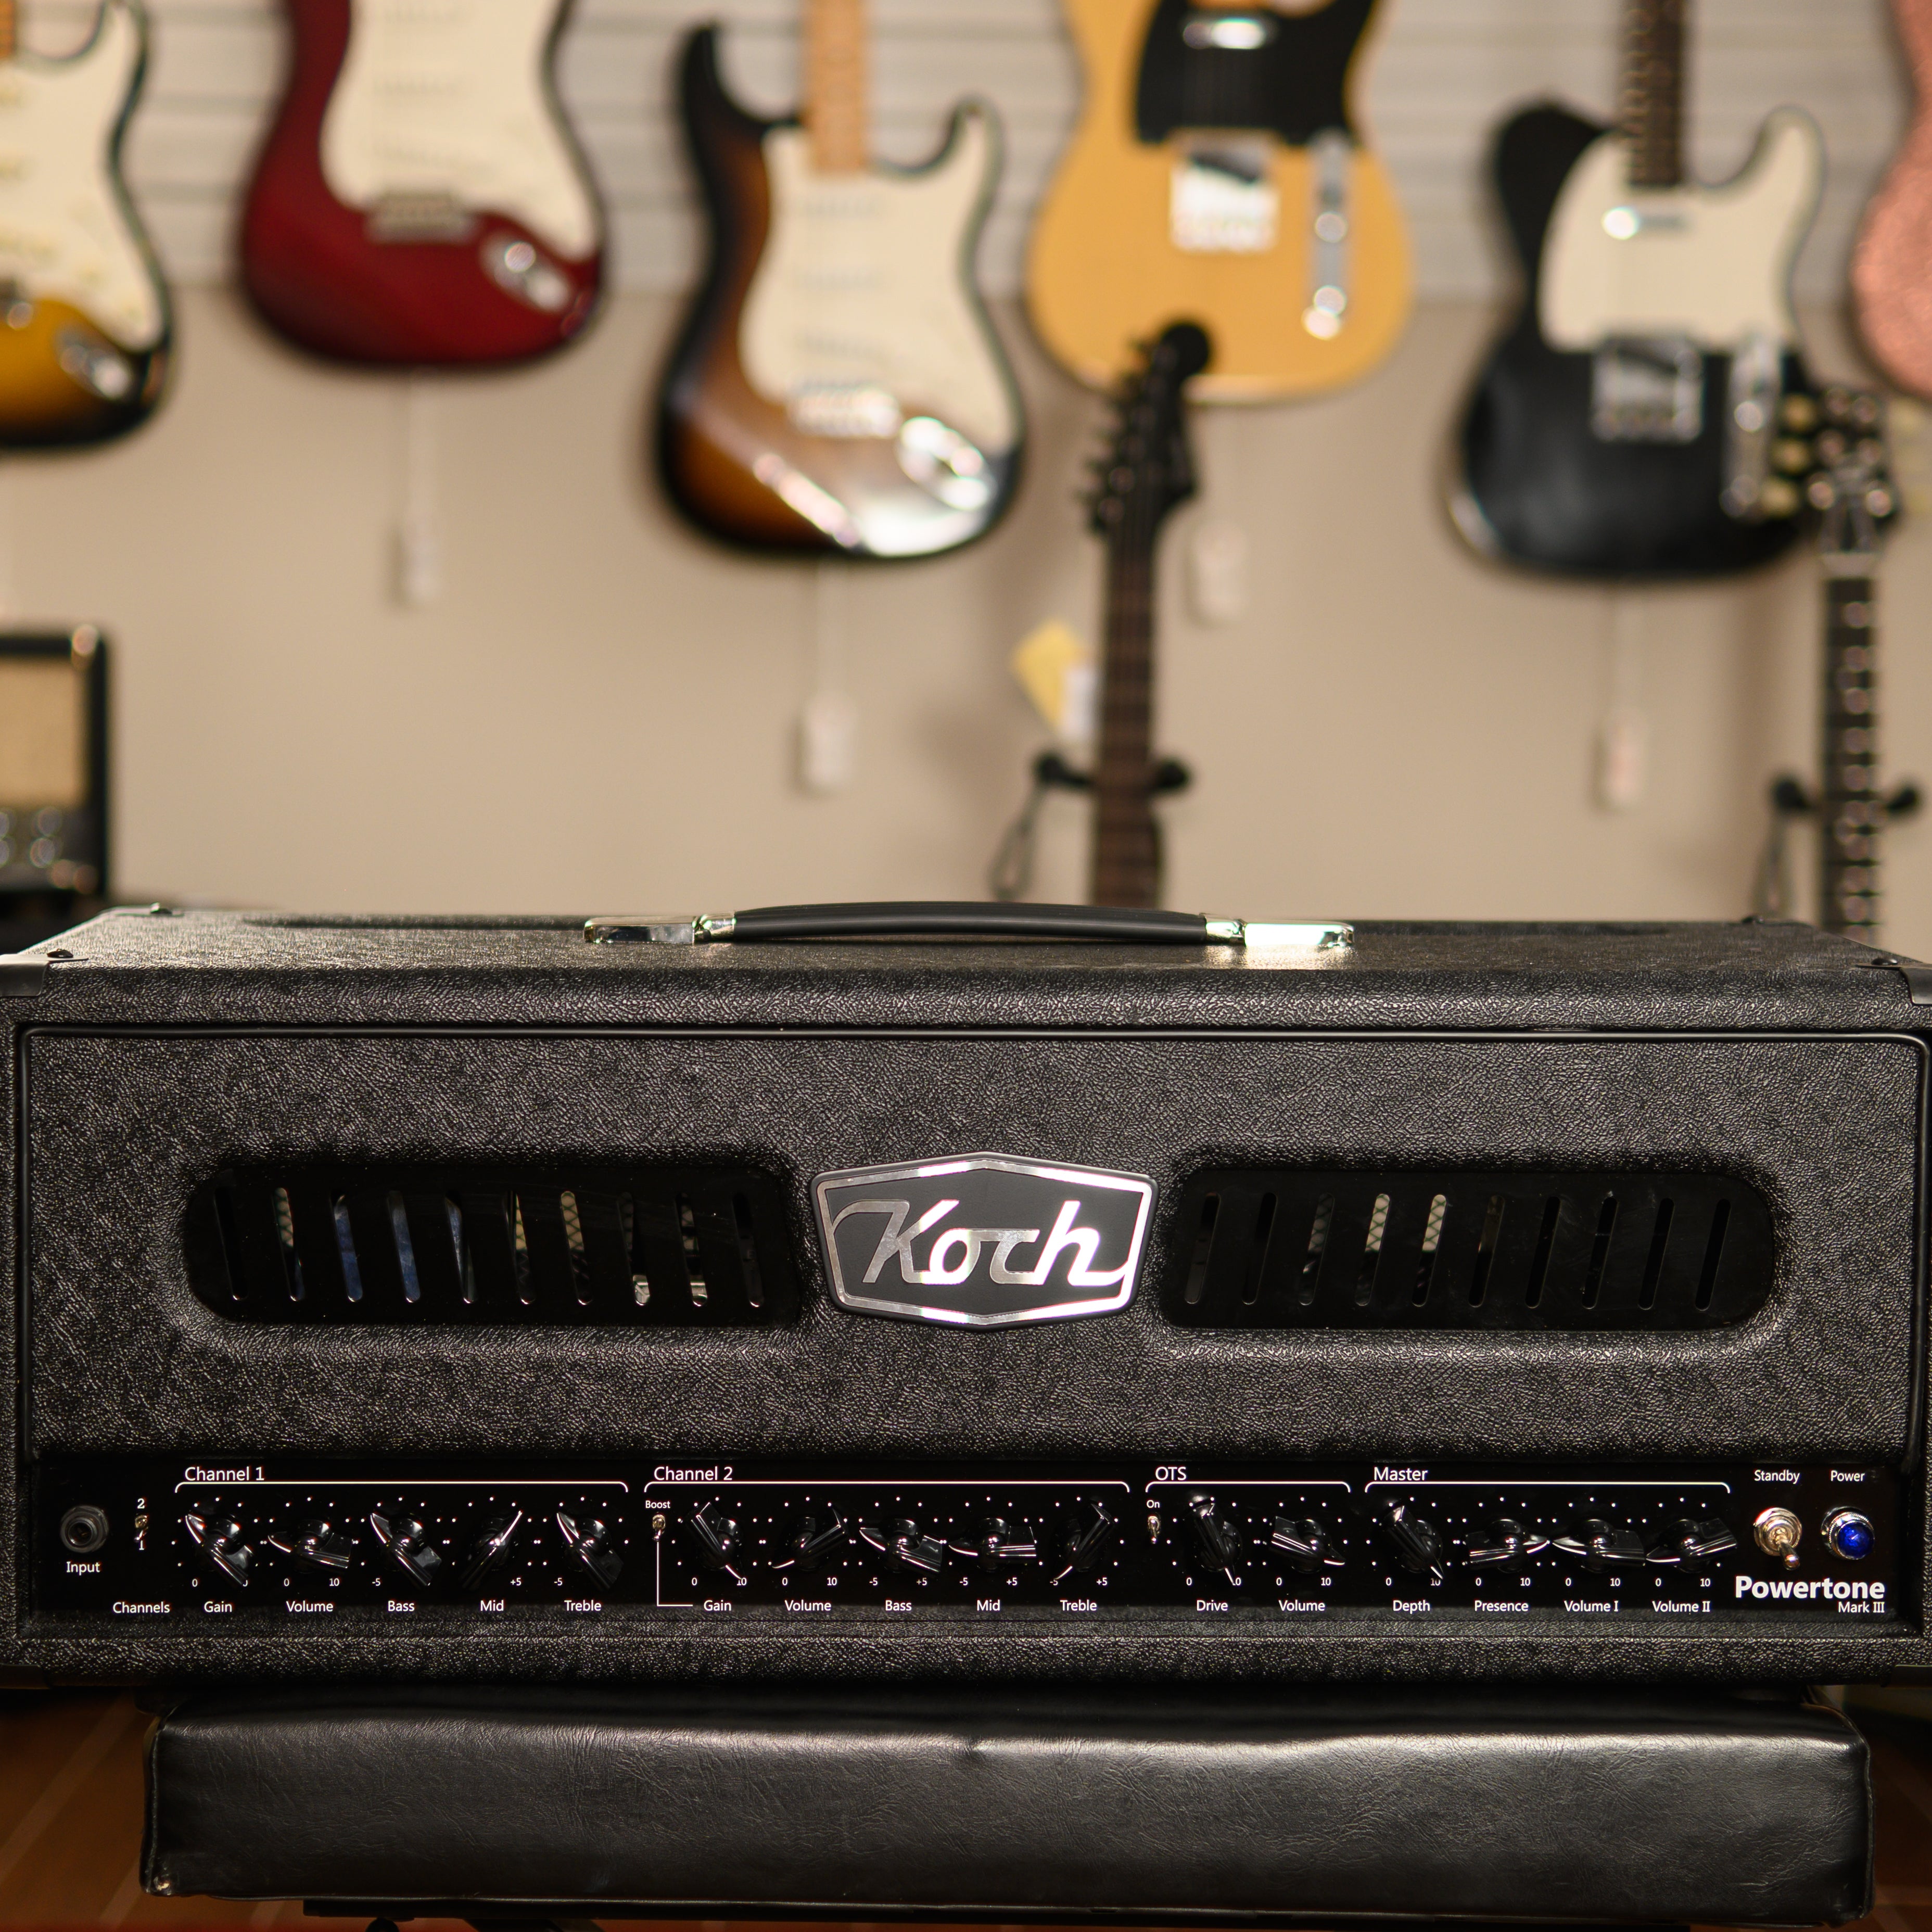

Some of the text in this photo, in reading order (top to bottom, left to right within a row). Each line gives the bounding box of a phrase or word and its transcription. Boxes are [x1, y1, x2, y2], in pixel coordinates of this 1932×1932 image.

[833, 1200, 1128, 1287] Koch
[185, 1466, 265, 1481] Channel 1
[654, 1466, 733, 1481] Channel 2
[1155, 1466, 1187, 1481] OTS
[1374, 1466, 1428, 1481] Master
[1754, 1469, 1800, 1484] Standby
[1831, 1470, 1865, 1482] Power
[137, 1498, 145, 1509] 2
[645, 1500, 671, 1509] Boost
[1146, 1499, 1160, 1508] On
[138, 1540, 145, 1550] 1
[66, 1561, 100, 1575] Input
[192, 1579, 198, 1587] 0
[284, 1578, 290, 1587] 0
[329, 1578, 340, 1586] 10
[372, 1578, 381, 1586] -5
[510, 1577, 522, 1586] +5
[554, 1577, 563, 1586] -5
[691, 1577, 697, 1586] 0
[782, 1577, 788, 1586] 0
[827, 1577, 837, 1586] 10
[869, 1577, 878, 1586] -5
[916, 1578, 927, 1586] +5
[959, 1577, 969, 1586] -5
[1006, 1577, 1018, 1586] +5
[1096, 1577, 1108, 1586] +5
[1186, 1577, 1192, 1586] 0
[1232, 1577, 1242, 1586] 0
[1276, 1577, 1282, 1586] 0
[1320, 1577, 1331, 1586] 10
[1386, 1577, 1392, 1586] 0
[1430, 1578, 1441, 1586] 10
[1475, 1577, 1482, 1586] 0
[1520, 1577, 1531, 1586] 10
[1565, 1578, 1572, 1586] 0
[1610, 1578, 1621, 1587] 10
[1655, 1578, 1662, 1587] 0
[1700, 1578, 1711, 1587] 10
[1735, 1575, 1885, 1599] Powertone
[112, 1601, 170, 1613] Channels
[204, 1600, 232, 1613] Gain
[286, 1600, 334, 1612] Volume
[388, 1600, 415, 1612] Bass
[480, 1599, 504, 1611] Mid
[564, 1599, 602, 1611] Treble
[703, 1599, 732, 1611] Gain
[784, 1599, 832, 1611] Volume
[885, 1599, 912, 1611] Bass
[976, 1599, 1000, 1611] Mid
[1060, 1599, 1098, 1611] Treble
[1197, 1599, 1228, 1611] Drive
[1278, 1599, 1326, 1611] Volume
[1393, 1599, 1431, 1615] Depth
[1475, 1600, 1529, 1612] Presence
[1564, 1599, 1611, 1612] Volume
[1651, 1600, 1699, 1612] Volume
[1838, 1600, 1870, 1613] Mark
